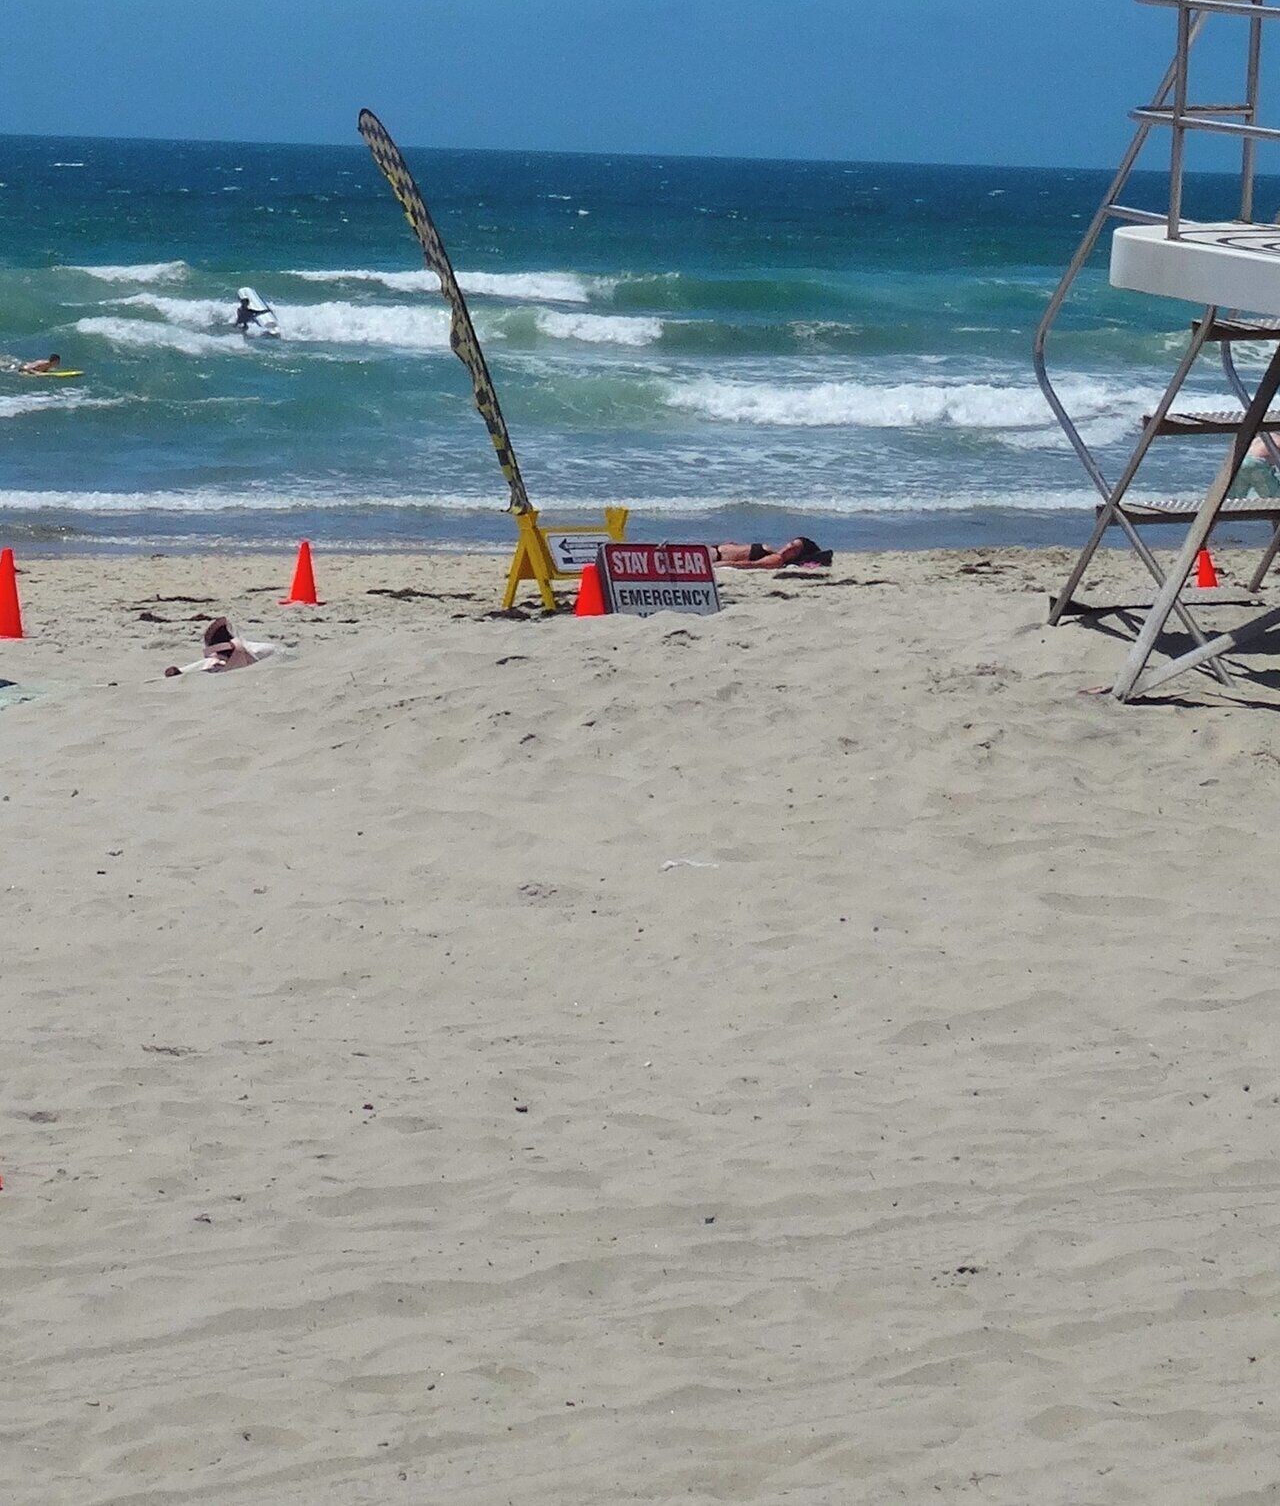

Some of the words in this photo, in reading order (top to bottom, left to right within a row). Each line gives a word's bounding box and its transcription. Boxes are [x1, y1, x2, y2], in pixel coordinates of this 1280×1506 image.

[612, 551, 648, 574] STAY
[654, 551, 707, 574] CLEAR
[619, 589, 710, 606] EMERGENCY
